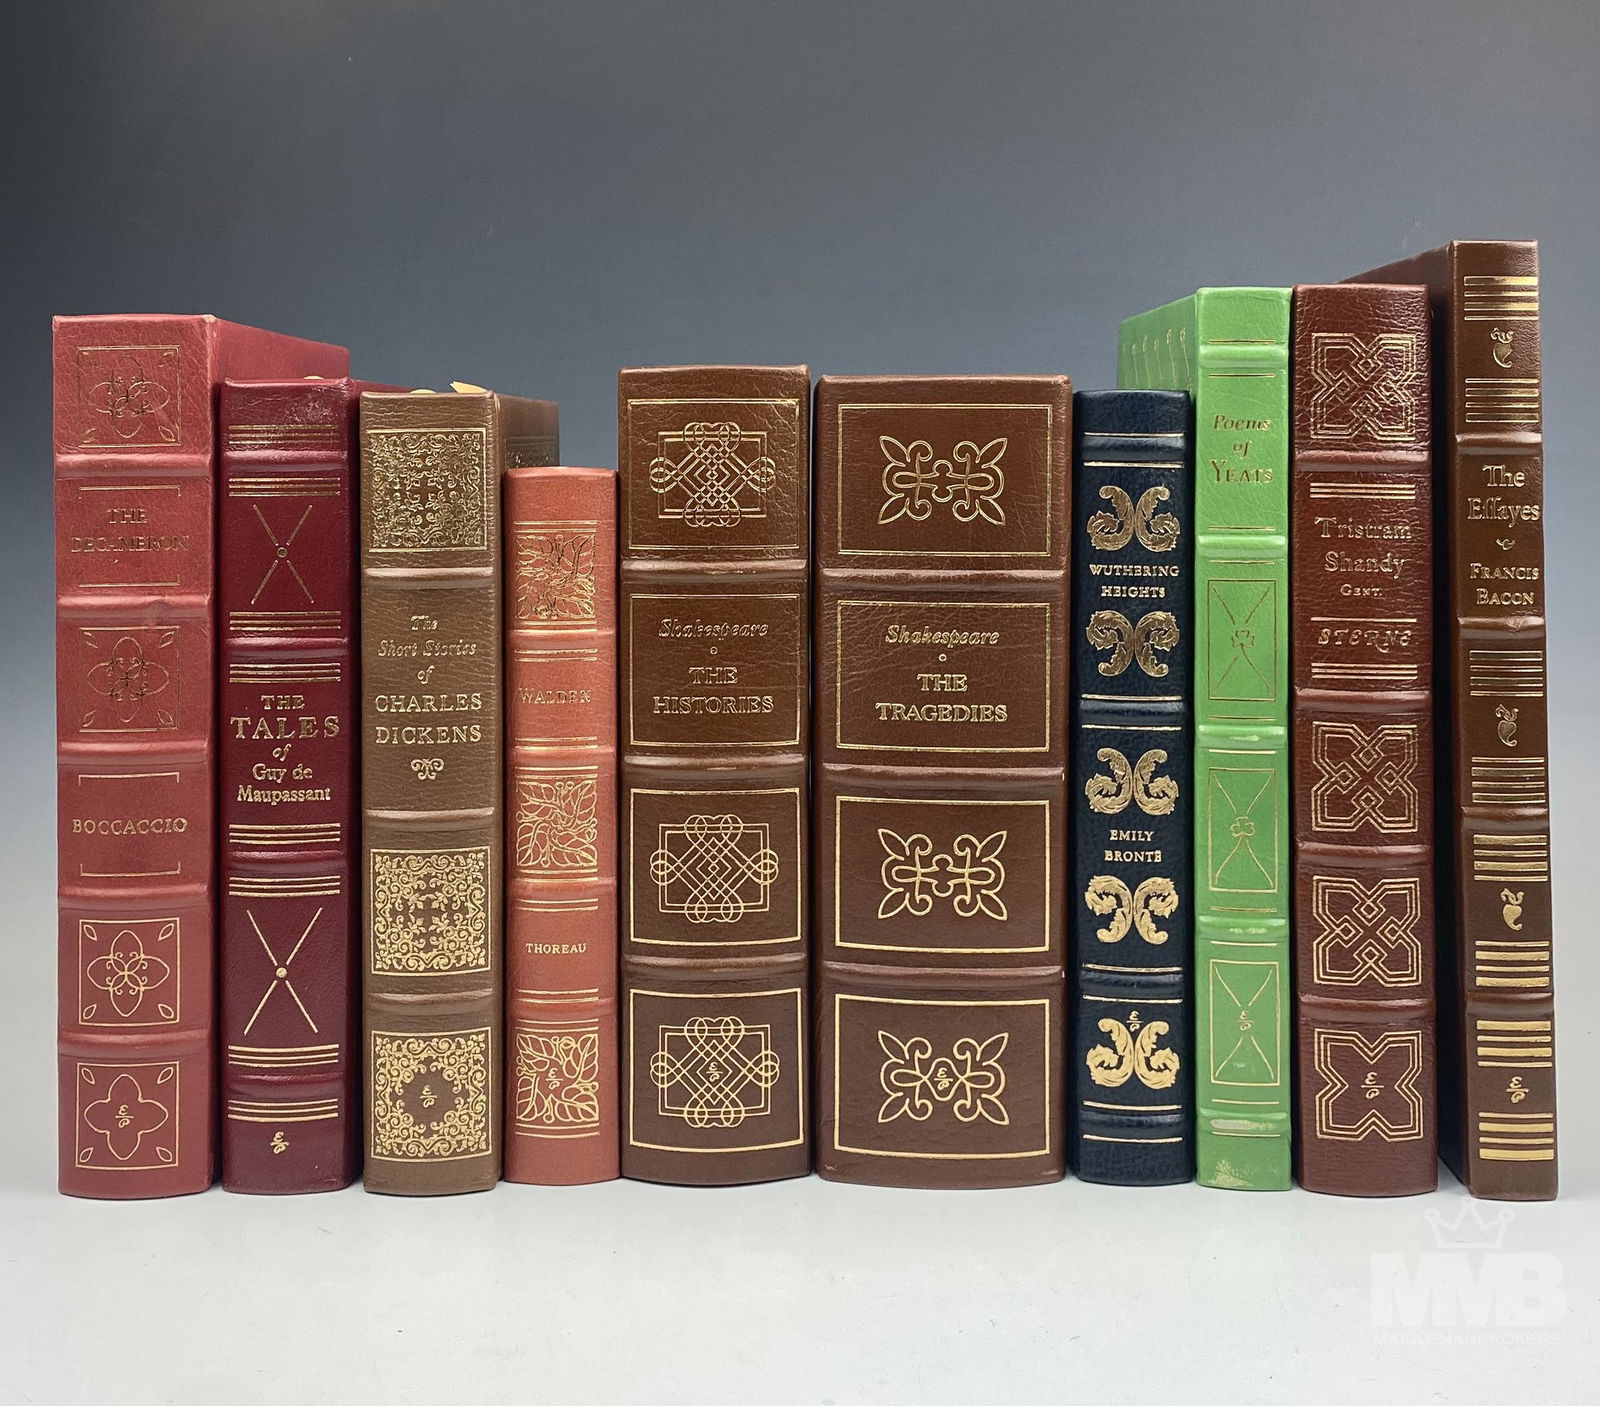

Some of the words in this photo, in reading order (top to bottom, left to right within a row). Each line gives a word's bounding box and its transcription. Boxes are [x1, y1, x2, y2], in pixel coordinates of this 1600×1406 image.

[1213, 414, 1272, 431] Poems
[1232, 440, 1253, 459] of
[1210, 459, 1273, 484] YEATS
[1482, 464, 1526, 487] The
[105, 508, 148, 524] THE
[1314, 516, 1412, 539] Tristram
[71, 535, 189, 553] DECAMERON
[1089, 564, 1180, 578] WUTHERING
[1324, 551, 1405, 579] Shandy
[1470, 563, 1540, 581] FRANCIS
[1101, 585, 1166, 599] HEIGHTS
[1476, 588, 1535, 606] BACON
[410, 615, 438, 631] The
[658, 618, 769, 640] Shakespeare
[885, 624, 1000, 648] Shakespeare
[1318, 628, 1412, 654] STERNE
[378, 639, 418, 656] Short
[422, 639, 478, 656] Stories
[417, 665, 435, 684] of
[689, 666, 738, 685] THE
[917, 673, 968, 692] THE
[261, 694, 305, 710] THE
[375, 692, 482, 713] CHARLES
[519, 688, 592, 705] WALDEN
[652, 694, 775, 715] HISTORIES
[875, 702, 1008, 724] TRAGEDIES
[231, 716, 340, 740] TALES
[375, 725, 482, 745] DICKENS
[272, 743, 291, 761] of
[252, 763, 286, 784] Guy
[292, 763, 313, 780] de
[237, 785, 331, 805] Maupassant
[72, 817, 188, 835] BOCCACCIO
[1109, 829, 1155, 843] EMILY
[526, 942, 588, 955] THOREAU
